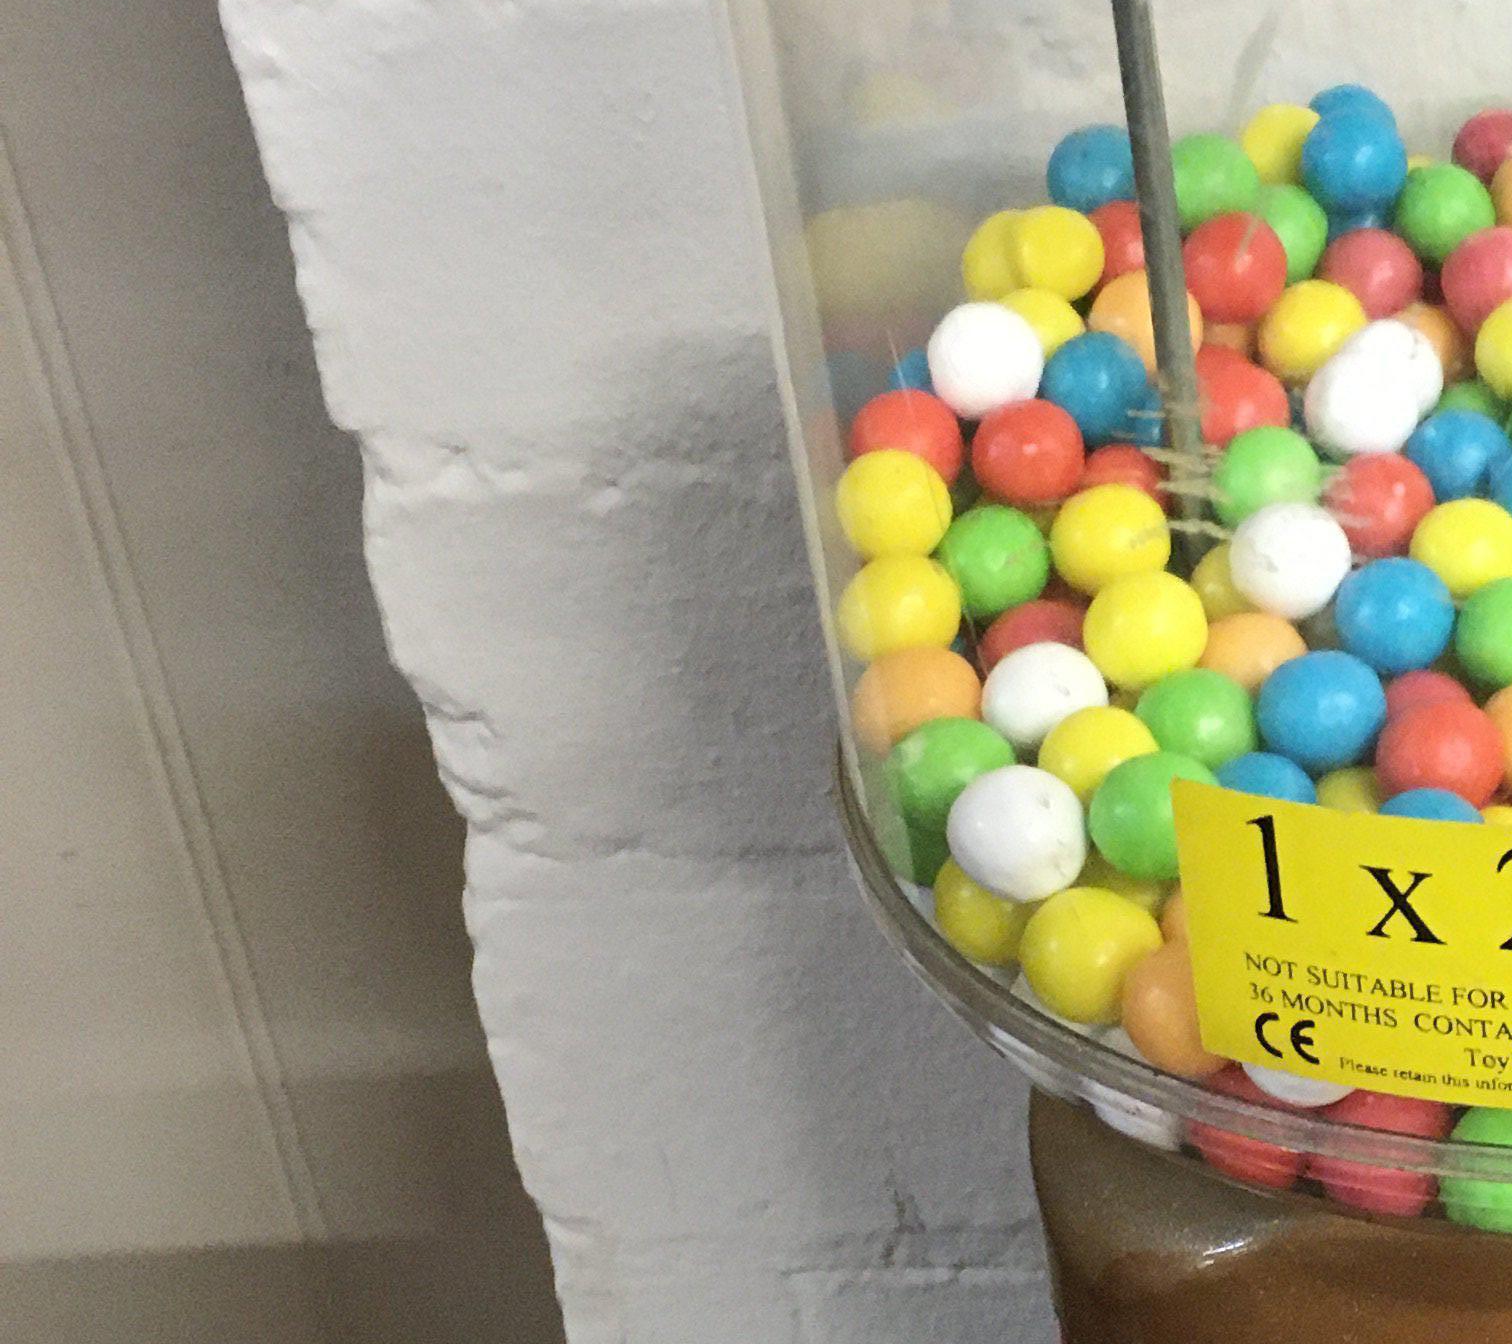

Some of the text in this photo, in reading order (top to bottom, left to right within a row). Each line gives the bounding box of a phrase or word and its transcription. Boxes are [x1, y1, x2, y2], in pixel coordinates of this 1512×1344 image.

[1246, 814, 1298, 924] 1
[1359, 863, 1447, 946] x
[1245, 952, 1298, 981] NOT
[1306, 964, 1443, 1004] SUITABLE
[1452, 987, 1508, 1011] FOR
[1249, 983, 1275, 1005] 36
[1281, 988, 1398, 1029] MONTHS
[1340, 1057, 1388, 1077] Please
[1393, 1068, 1438, 1084] retain
[1441, 1073, 1471, 1088] this
